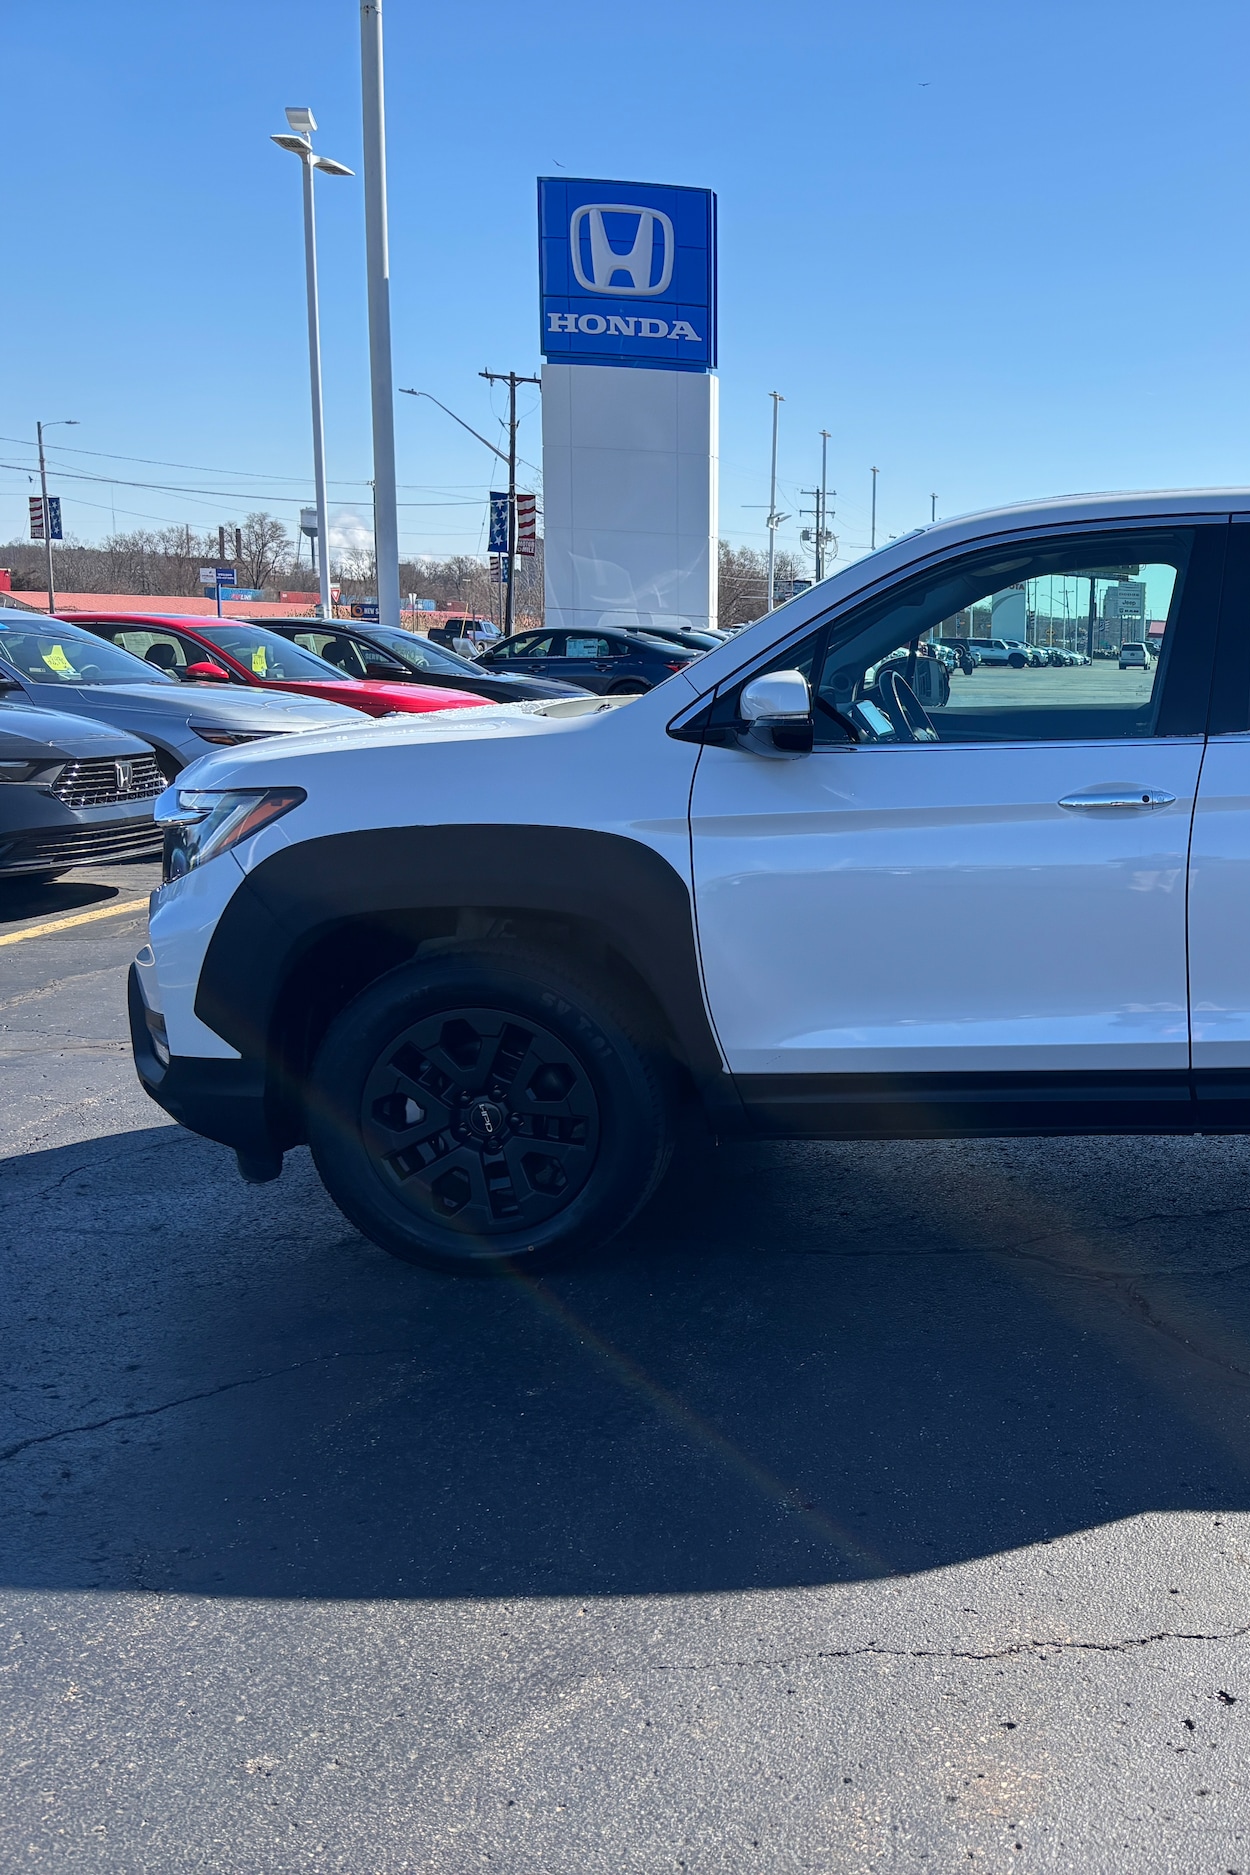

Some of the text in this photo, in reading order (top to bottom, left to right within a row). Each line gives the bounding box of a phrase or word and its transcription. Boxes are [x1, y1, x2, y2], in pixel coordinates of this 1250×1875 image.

[547, 312, 703, 342] HONDA
[1122, 599, 1137, 607] Jeep
[478, 1103, 493, 1133] HPD
